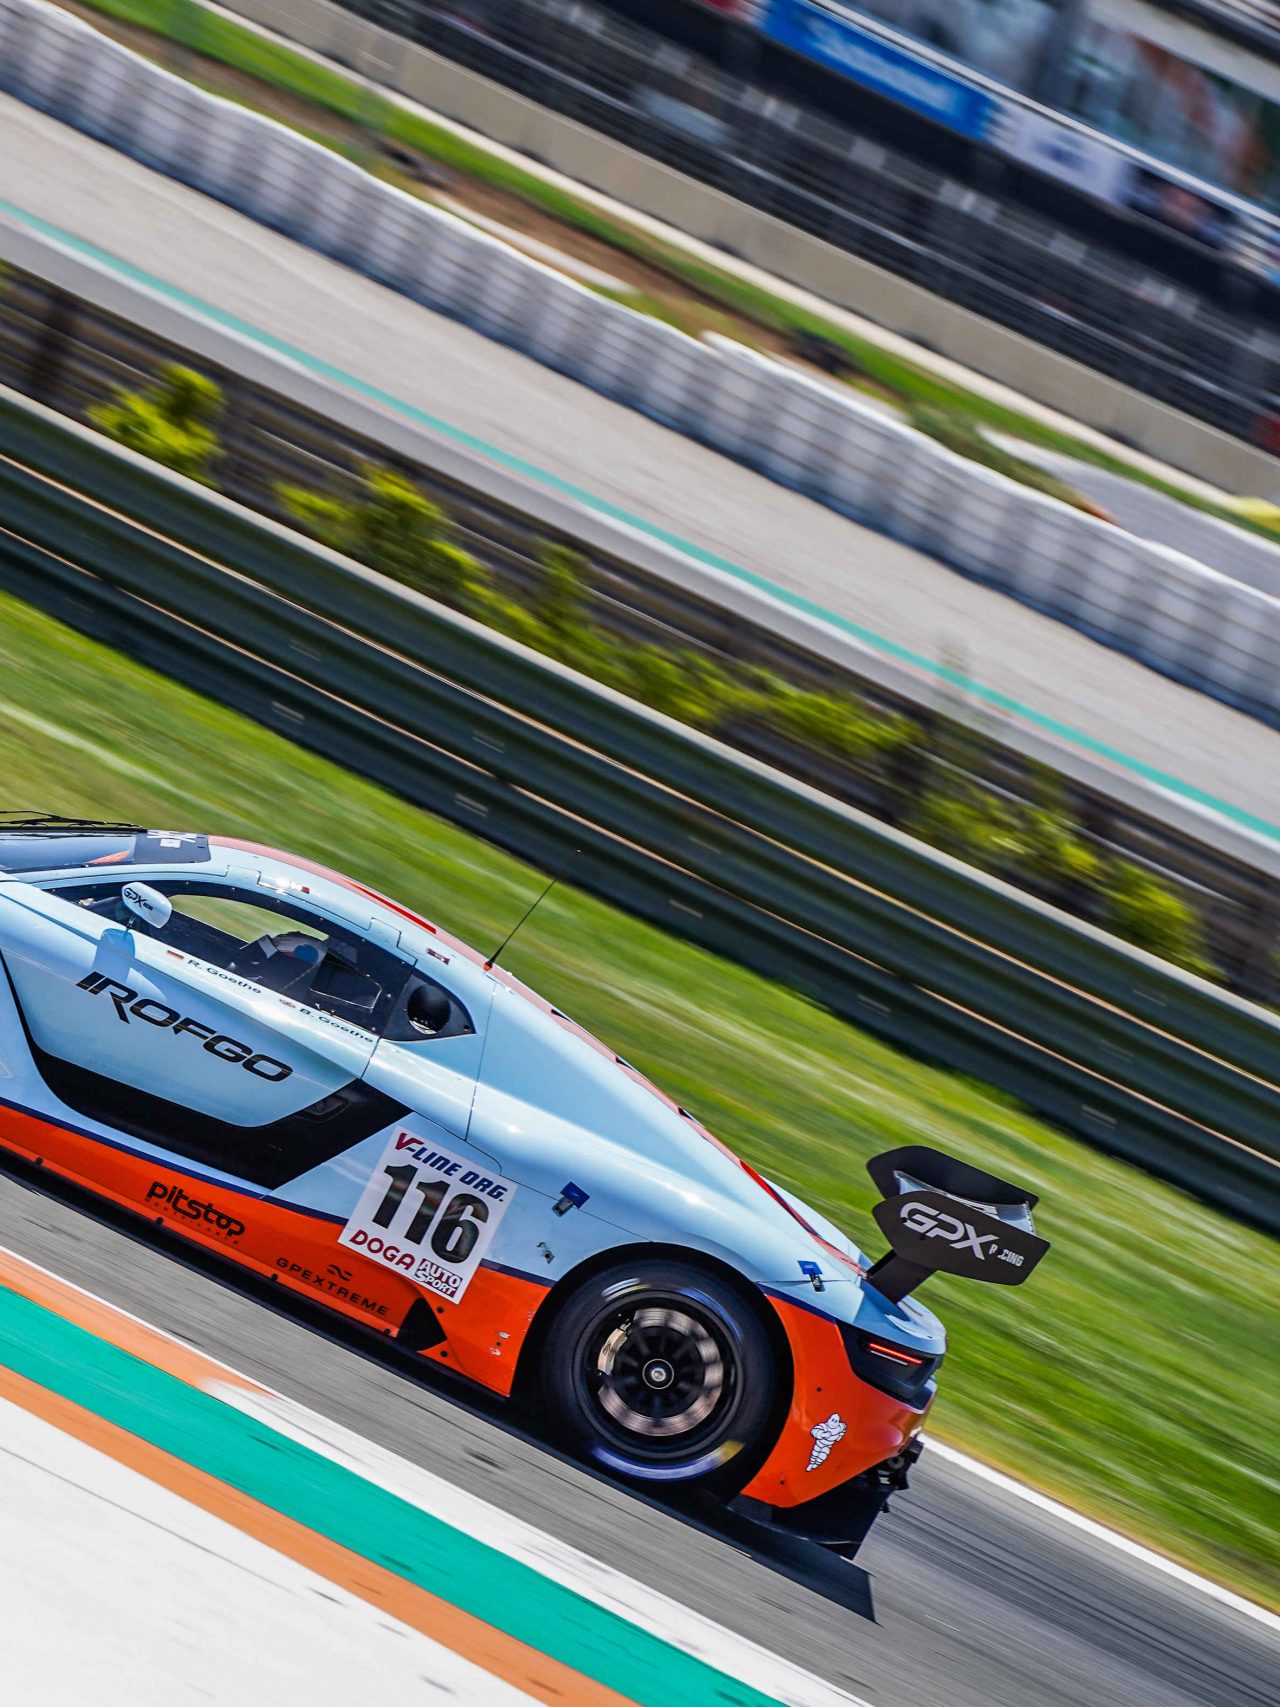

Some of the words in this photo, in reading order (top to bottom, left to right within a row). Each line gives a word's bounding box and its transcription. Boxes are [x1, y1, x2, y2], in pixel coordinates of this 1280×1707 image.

[123, 887, 148, 908] GPX
[187, 959, 202, 970] R.
[206, 967, 262, 994] Goethe
[318, 1015, 374, 1043] Goethe
[395, 1132, 463, 1177] V-LINE
[459, 1170, 508, 1202] ORG.
[146, 1181, 246, 1237] pitstop
[372, 1164, 489, 1264] 116
[349, 1229, 416, 1271] DOGA
[899, 1201, 1000, 1261] GPX
[276, 1257, 389, 1315] GPEXTREME
[414, 1269, 457, 1295] SPORT
[419, 1259, 461, 1289] AUTO
